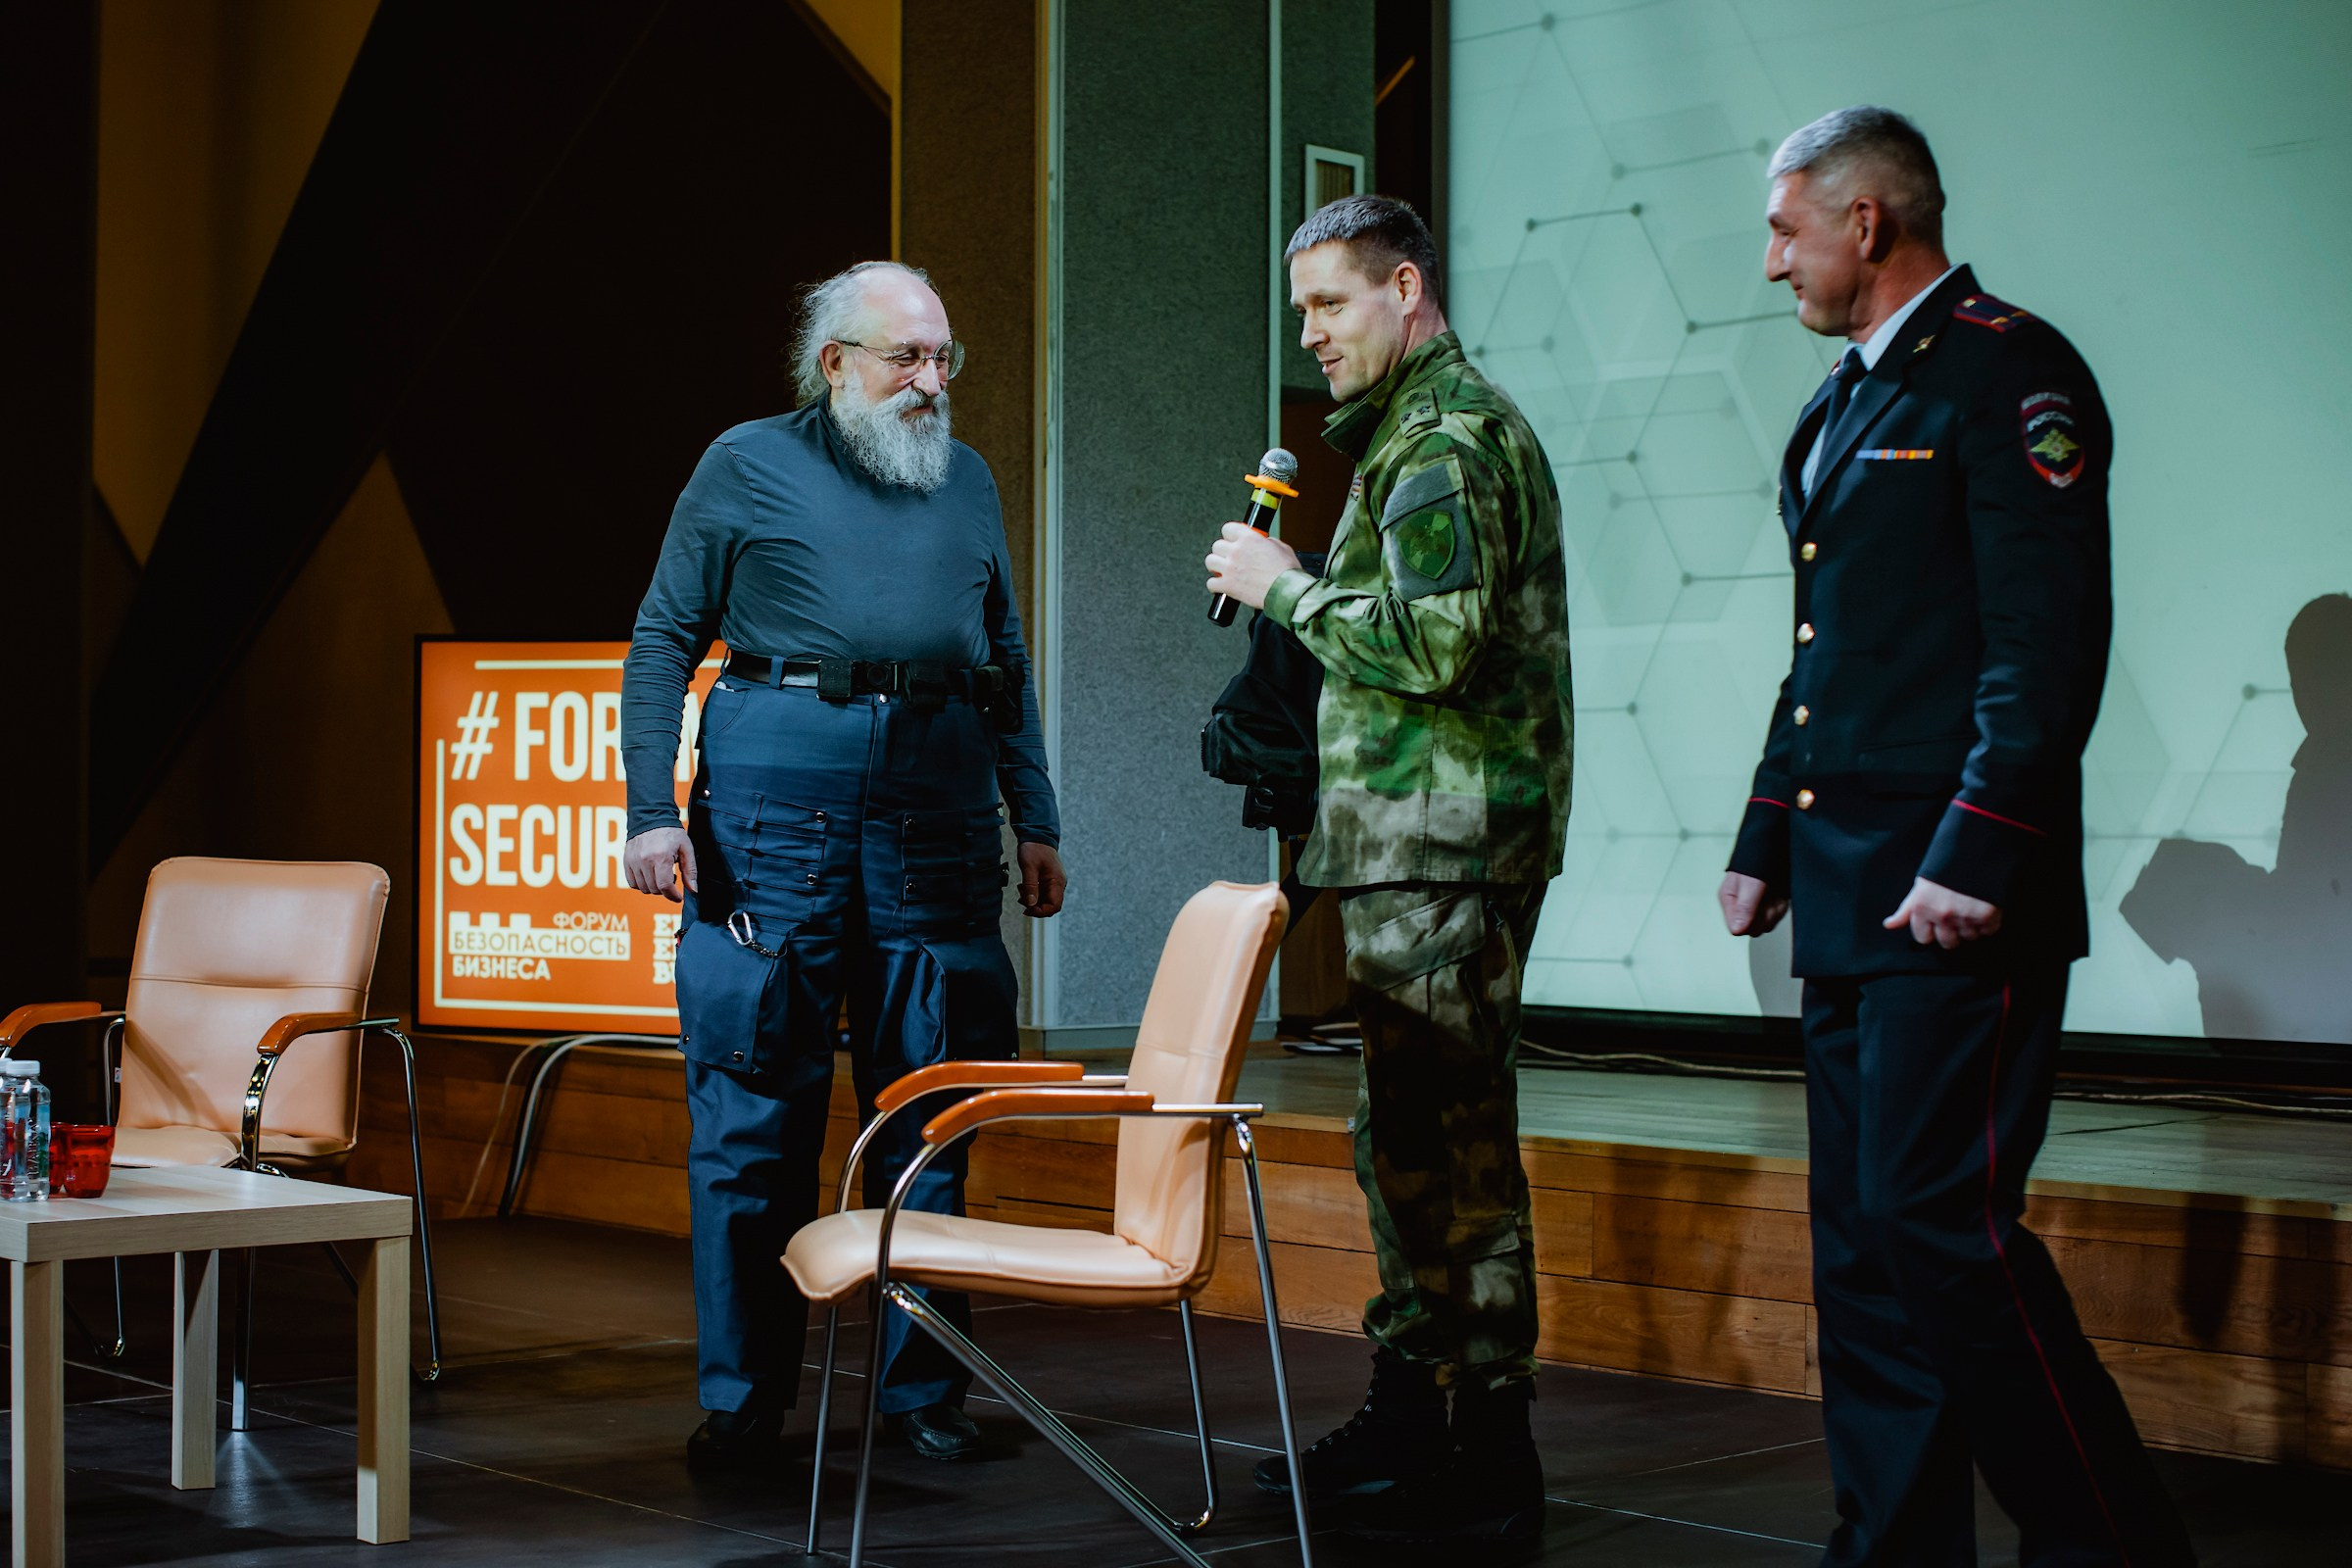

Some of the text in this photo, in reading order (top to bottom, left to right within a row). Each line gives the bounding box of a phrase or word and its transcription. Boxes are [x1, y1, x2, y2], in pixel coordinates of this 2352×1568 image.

[514, 691, 700, 782] FOR
[449, 804, 688, 888] SECUR
[553, 911, 629, 931] ФОРУМ
[454, 931, 627, 956] БЕЗОПАСНОСТЬ
[452, 955, 551, 981] БИЗНЕСА
